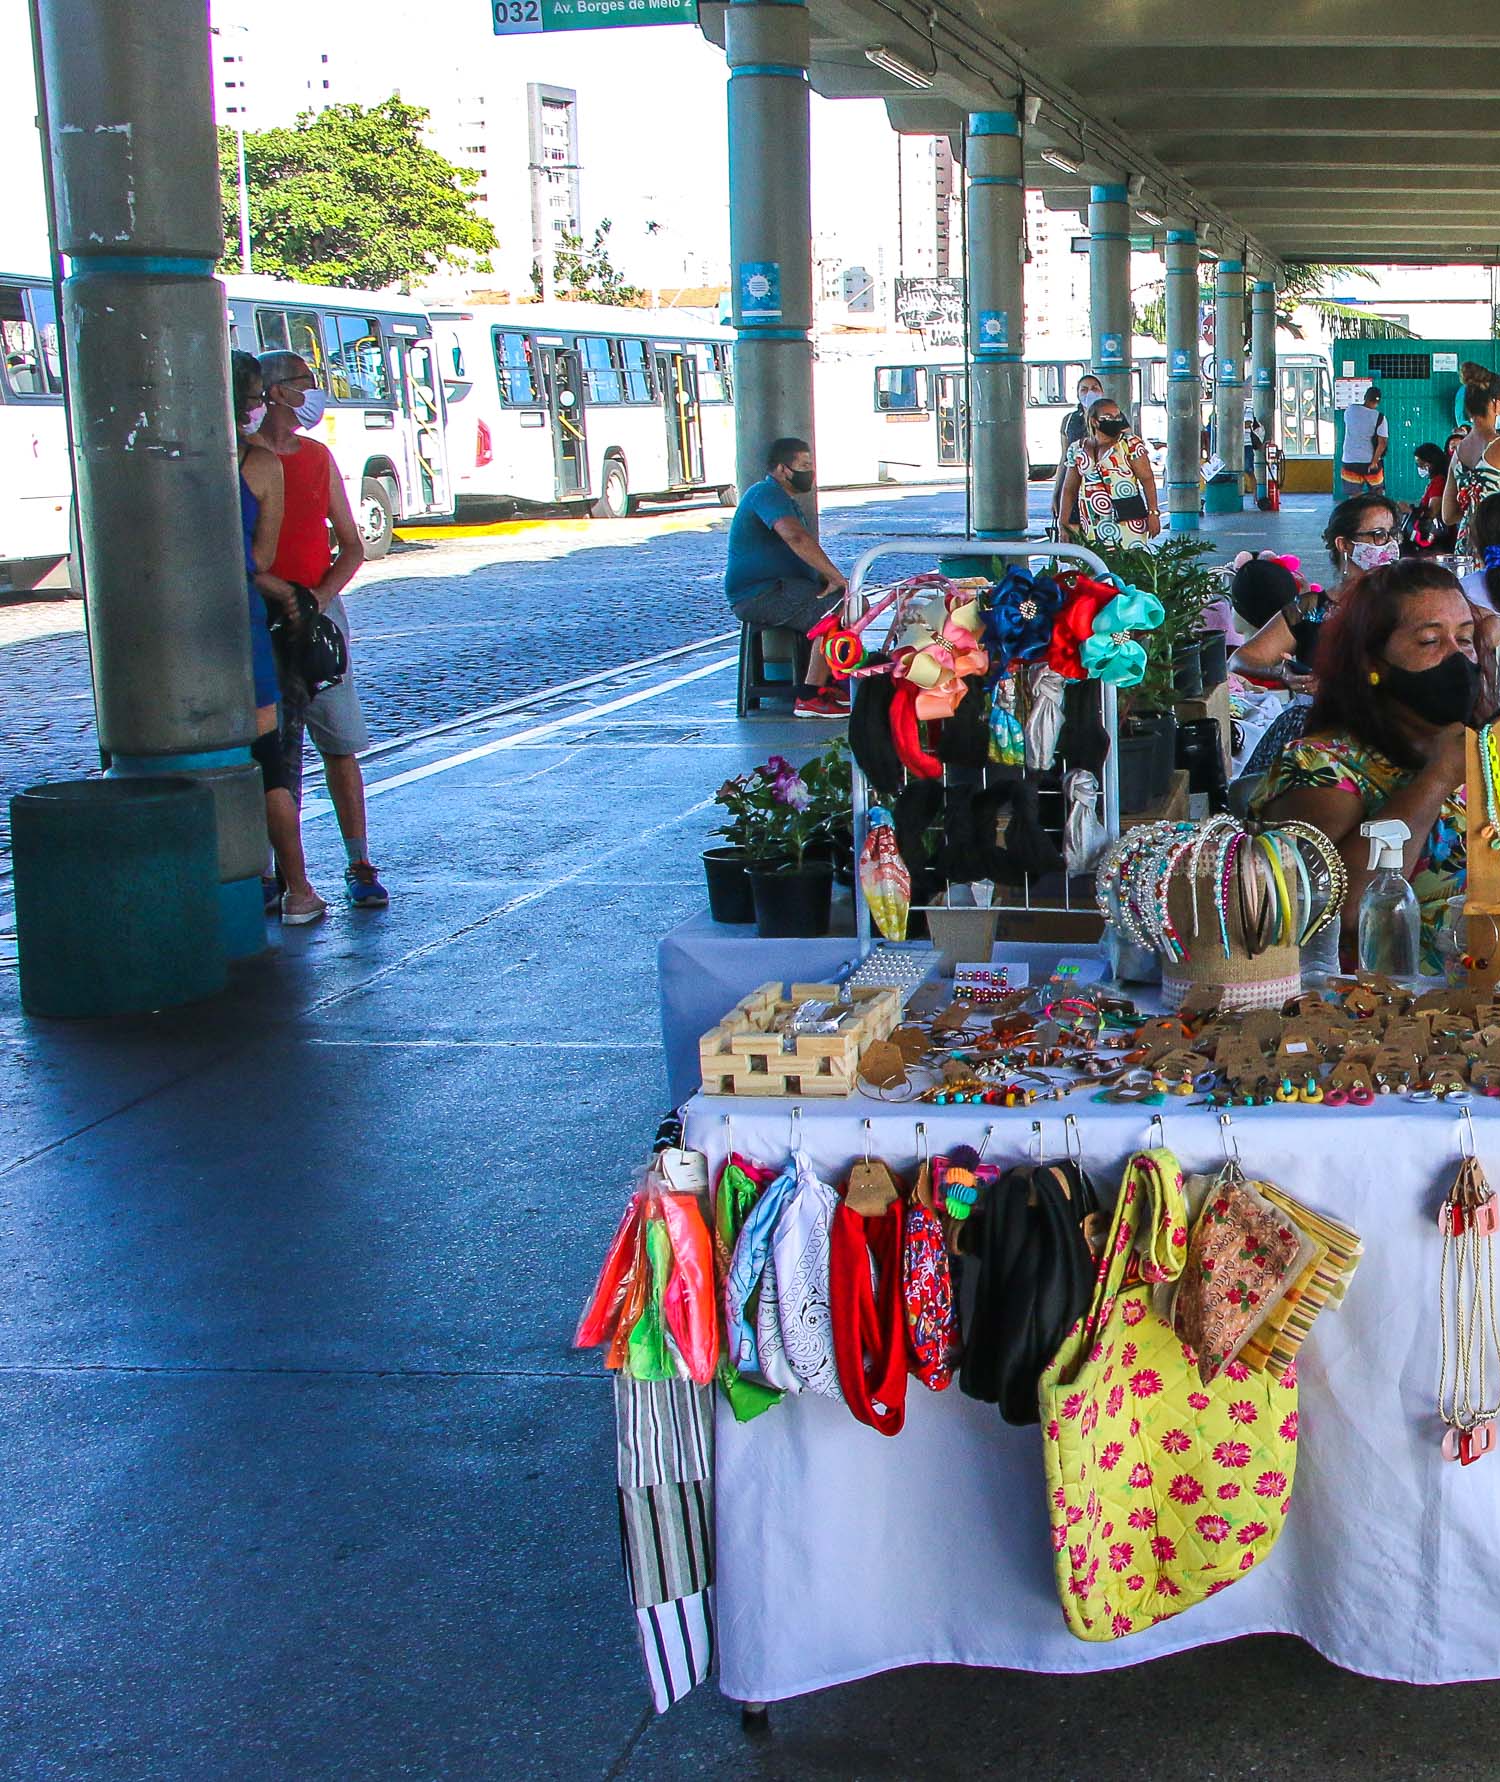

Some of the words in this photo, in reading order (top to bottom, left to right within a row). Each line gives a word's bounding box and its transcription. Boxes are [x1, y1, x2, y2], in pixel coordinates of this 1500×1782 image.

[494, 1, 539, 23] 032
[553, 3, 573, 14] Av.
[577, 0, 625, 14] Borges
[629, 0, 645, 10] de
